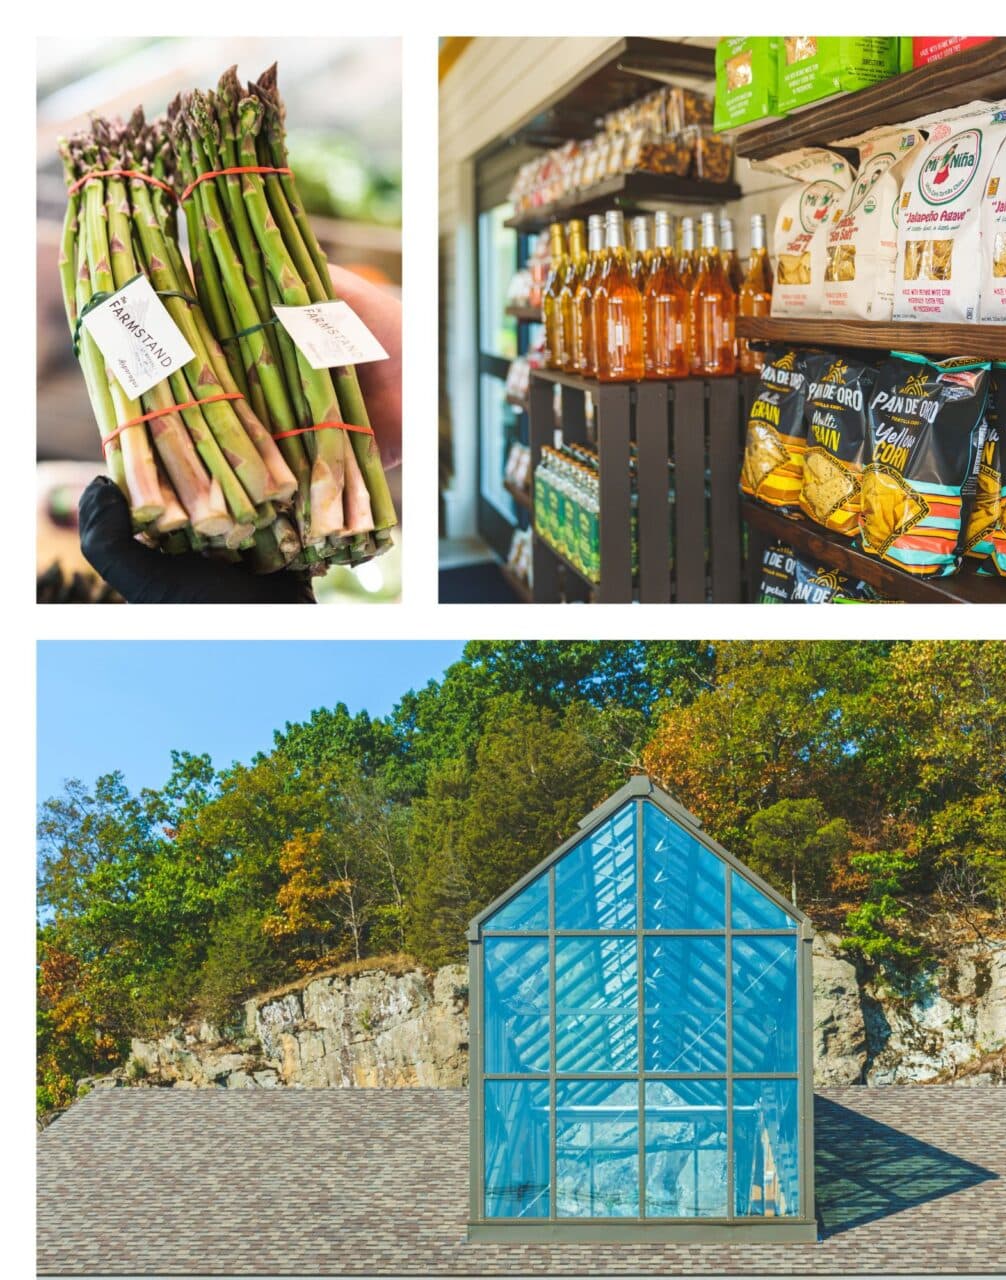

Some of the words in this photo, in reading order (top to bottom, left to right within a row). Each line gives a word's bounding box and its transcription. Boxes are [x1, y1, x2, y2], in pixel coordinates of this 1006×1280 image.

[925, 159, 938, 172] Mi
[950, 152, 974, 168] Niña
[109, 300, 172, 367] FARMSTAND
[822, 386, 834, 400] DE
[837, 387, 862, 411] ORO
[871, 391, 904, 413] PAN
[905, 398, 919, 415] DE
[920, 400, 939, 424] ORO
[750, 400, 780, 426] GRAIN
[812, 410, 838, 429] Multi
[811, 425, 840, 452] RAIN
[875, 422, 916, 448] Yellow
[873, 440, 910, 472] CORN
